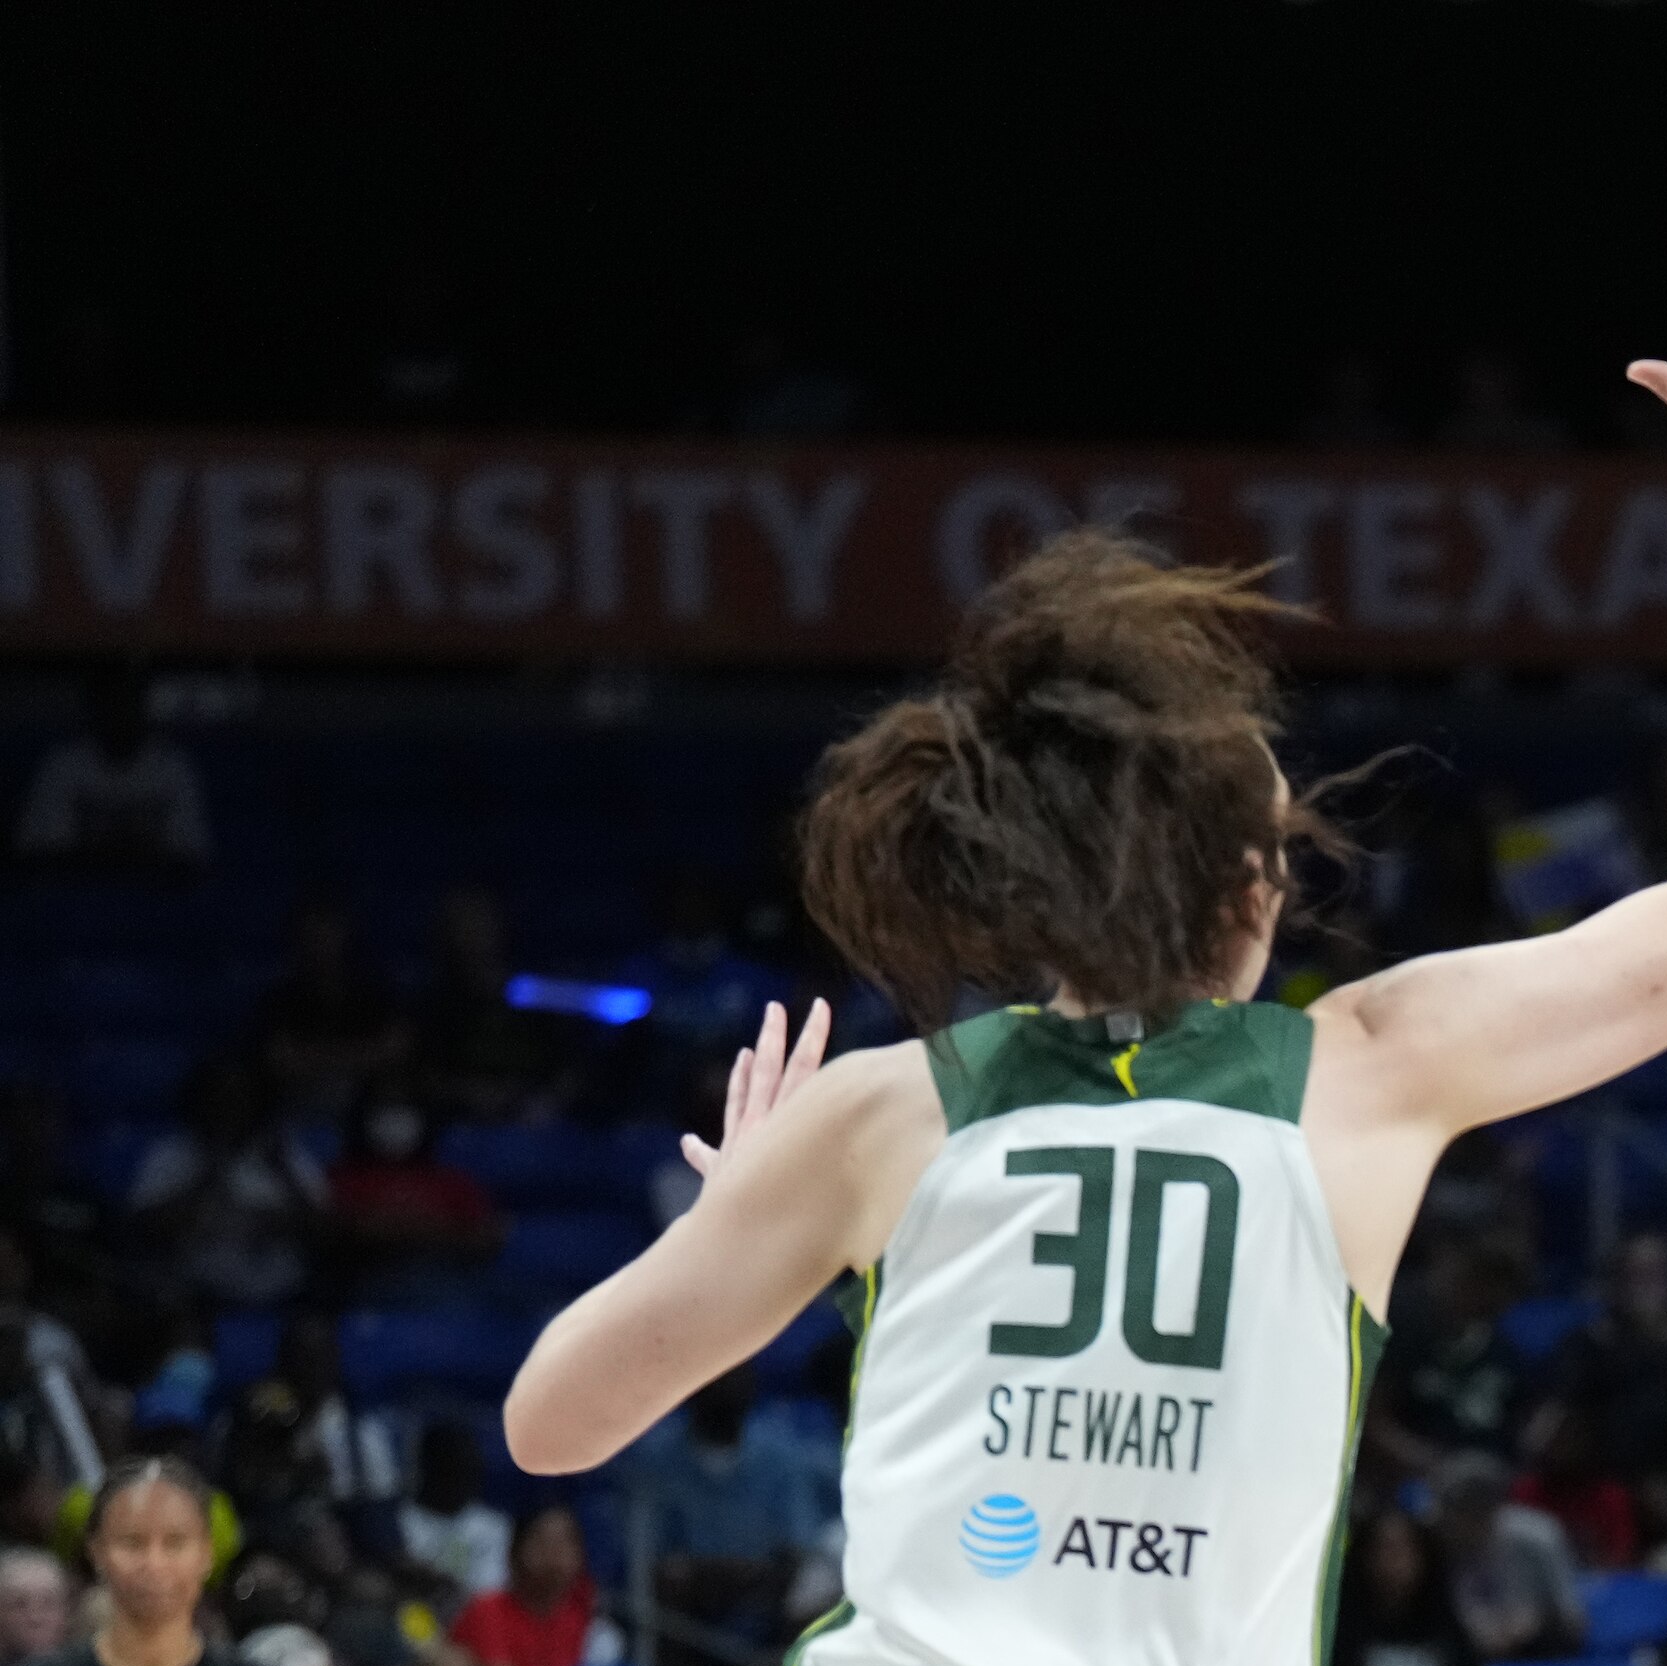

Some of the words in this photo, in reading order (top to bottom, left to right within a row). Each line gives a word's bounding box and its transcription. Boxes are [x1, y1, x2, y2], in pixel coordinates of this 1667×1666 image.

[988, 1146, 1240, 1370] 30
[983, 1384, 1214, 1474] STEWART
[1054, 1516, 1208, 1578] AT&T
